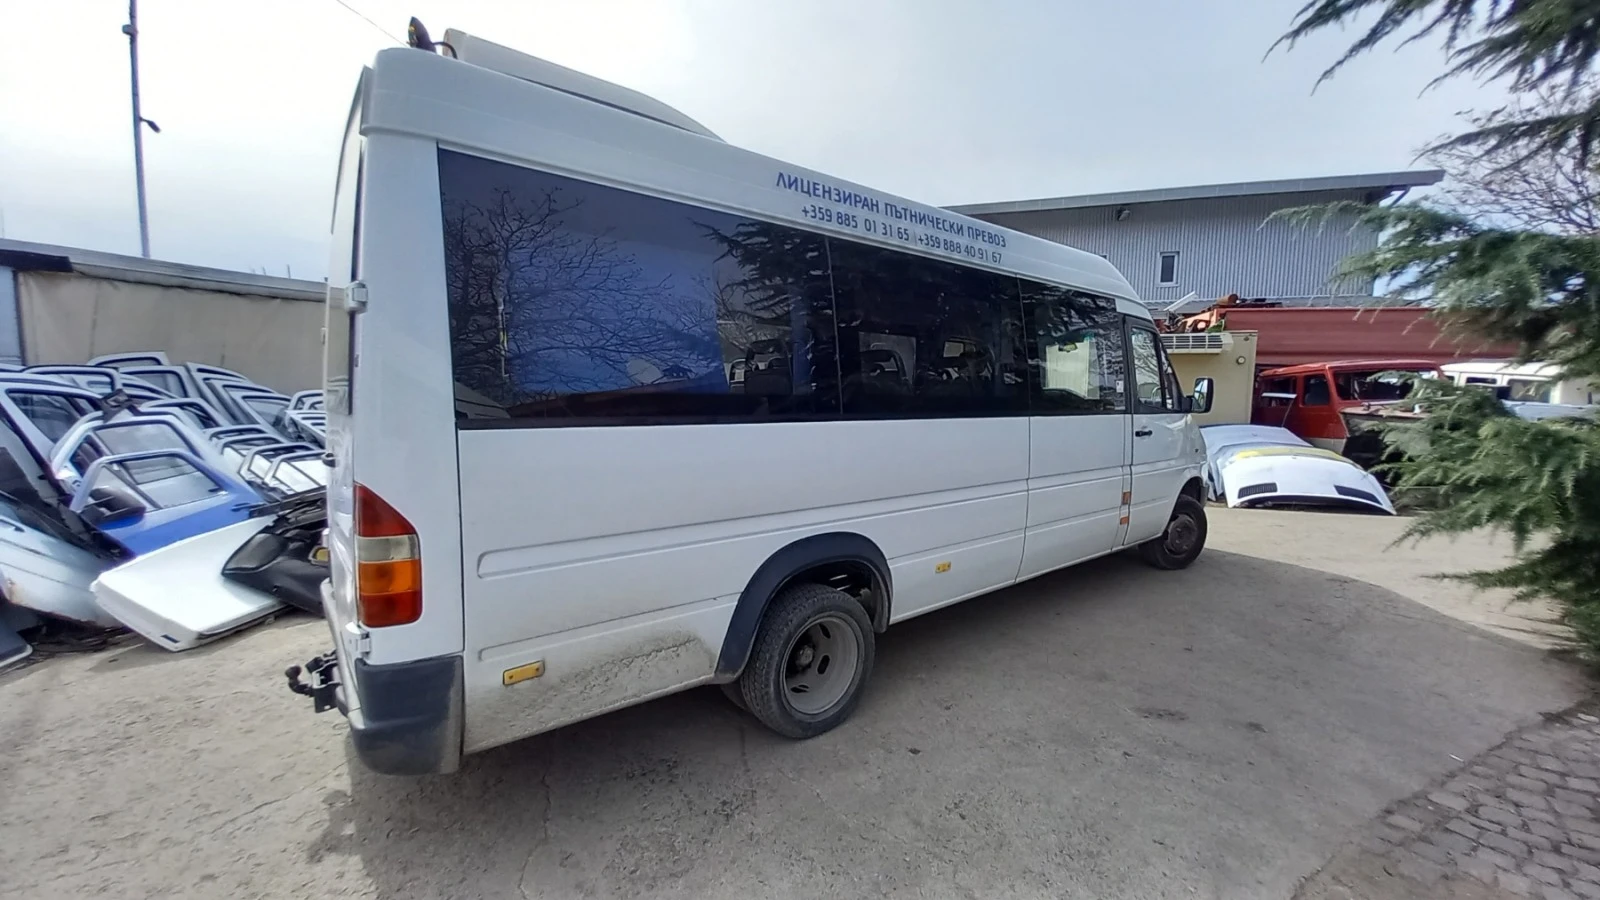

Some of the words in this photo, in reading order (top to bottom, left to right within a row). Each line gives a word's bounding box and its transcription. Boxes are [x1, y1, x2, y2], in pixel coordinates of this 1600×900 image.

[776, 172, 880, 214] ЛИЦЕНЗИРАН
[884, 202, 965, 237] ПЪТНИЧЕСКИ
[967, 226, 1007, 248] ПРЕВОЗ
[801, 204, 833, 223] +359
[836, 211, 858, 229] 885
[864, 218, 877, 233] 01
[881, 223, 893, 237] 31
[897, 226, 910, 241] 65
[918, 233, 941, 249] +359
[943, 239, 962, 254] 888
[964, 244, 976, 258] 40
[978, 248, 988, 261] 91
[992, 252, 1002, 264] 67
